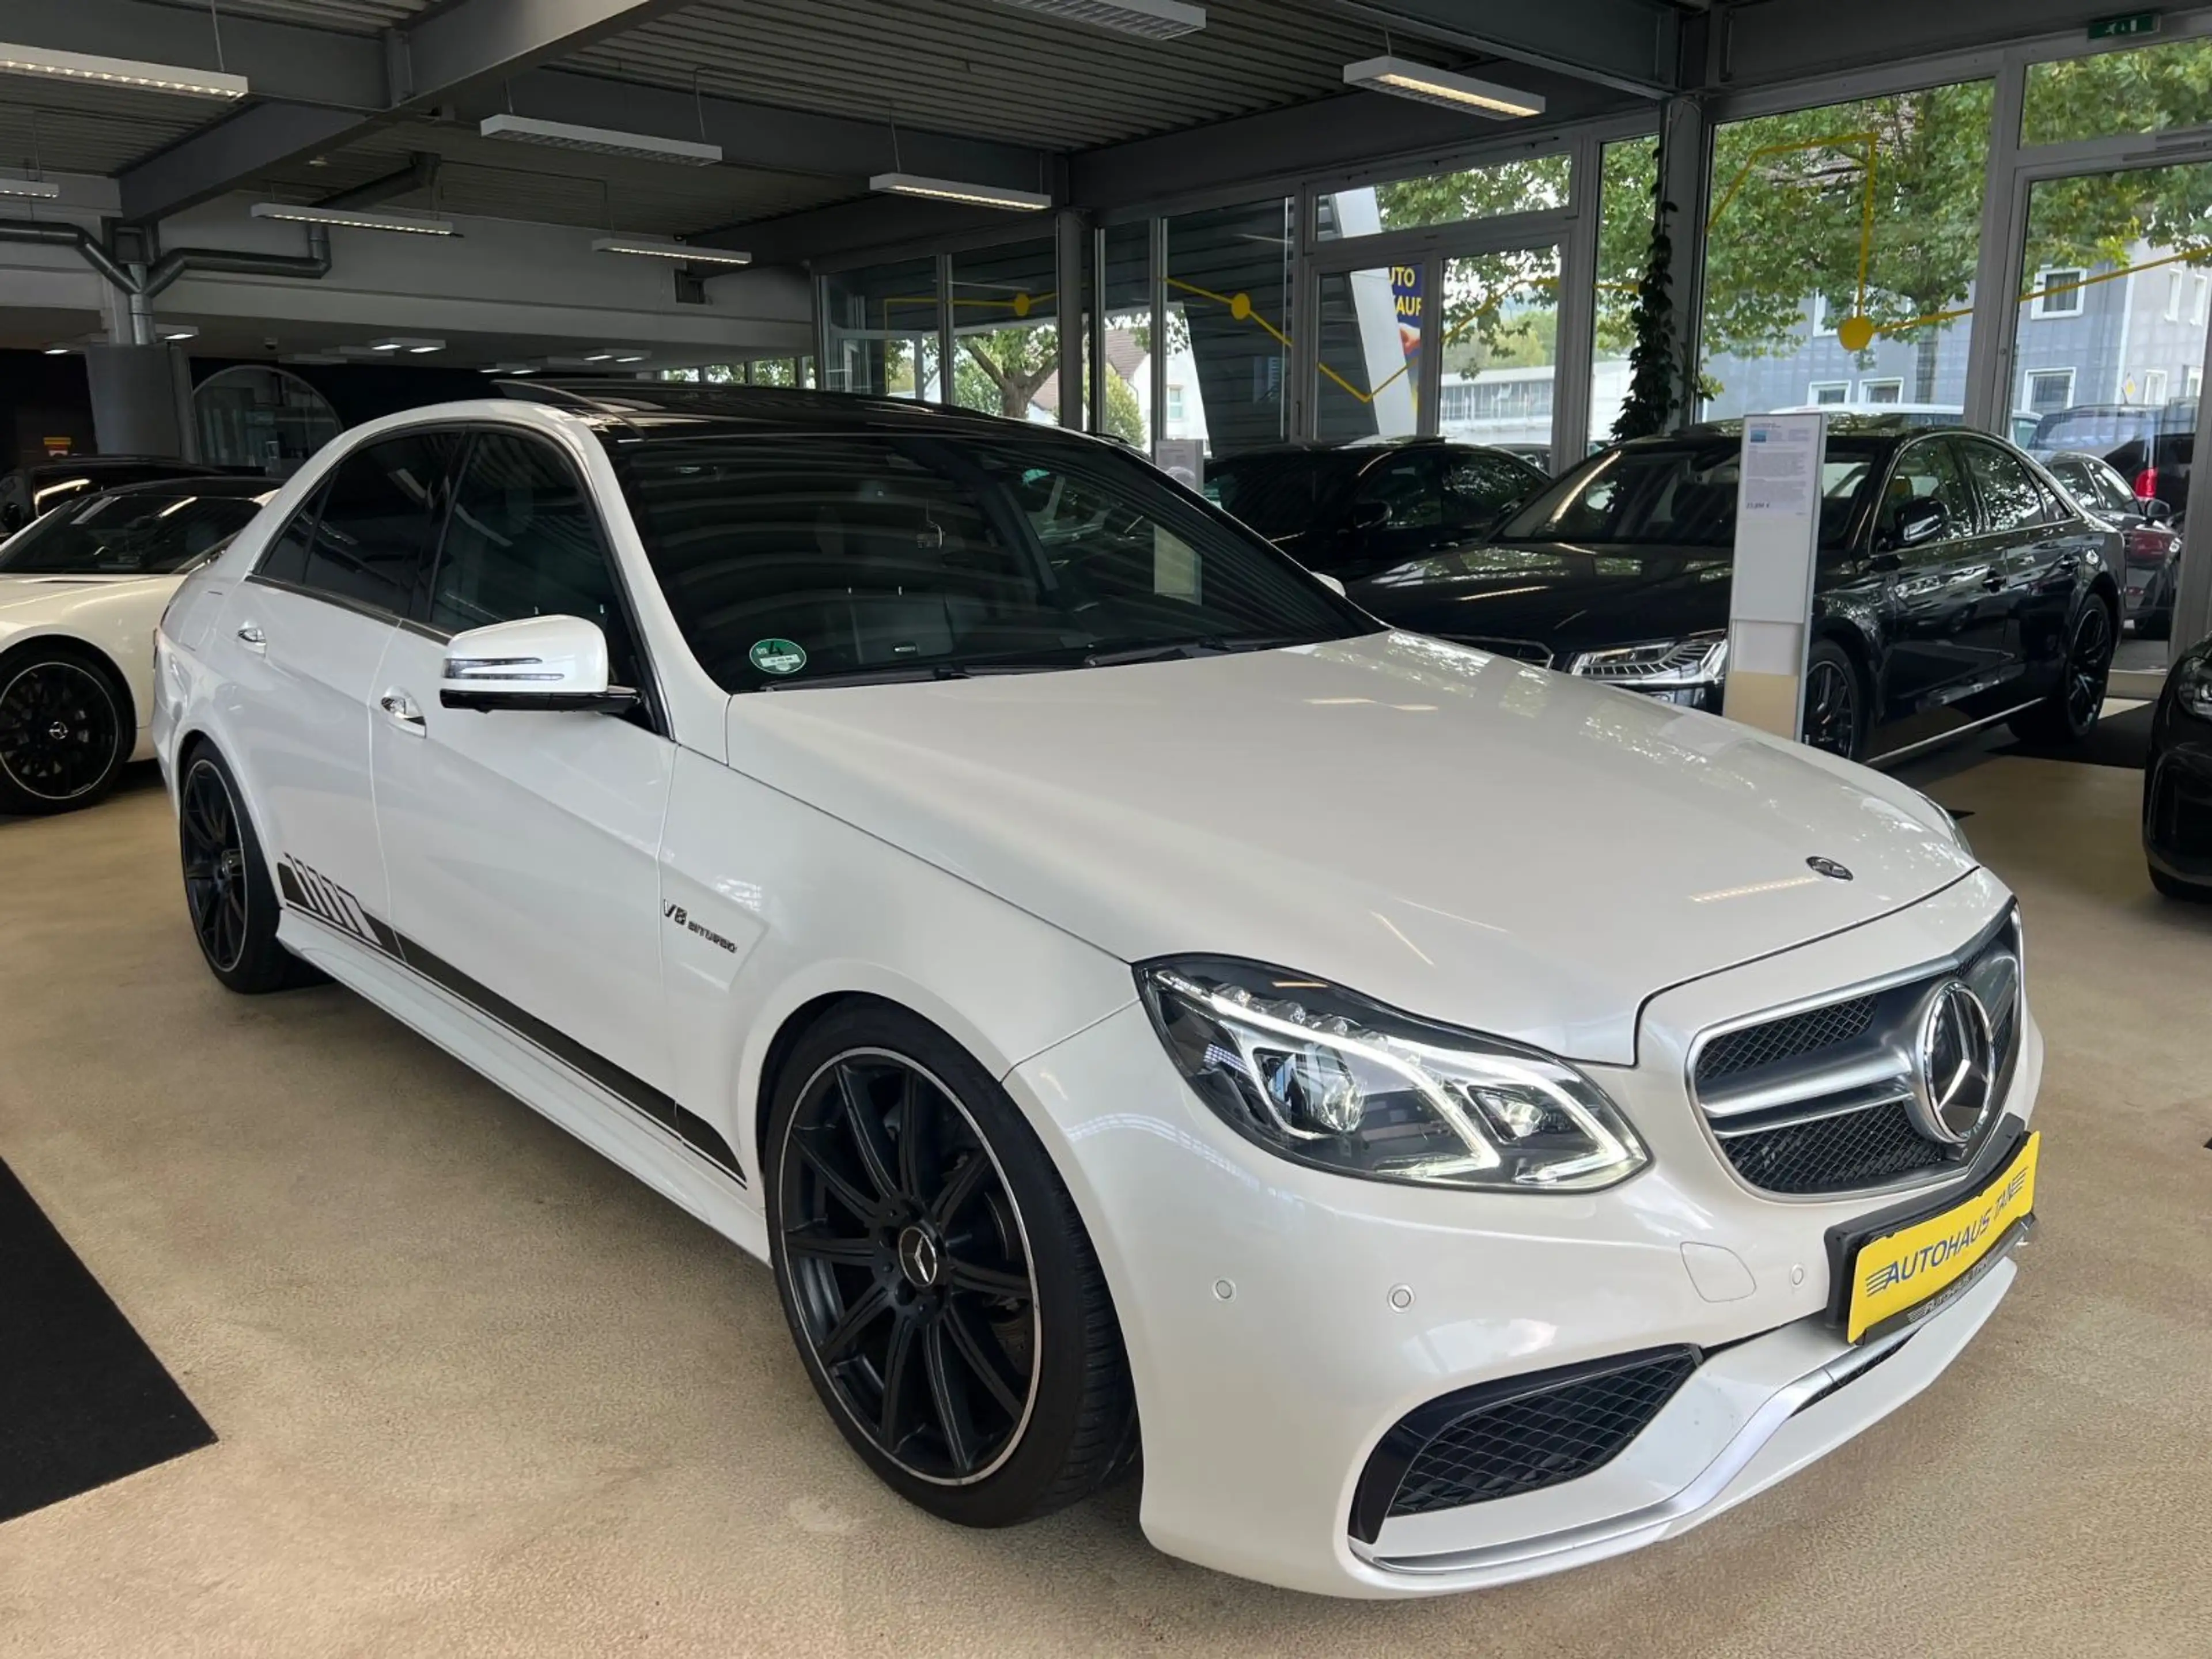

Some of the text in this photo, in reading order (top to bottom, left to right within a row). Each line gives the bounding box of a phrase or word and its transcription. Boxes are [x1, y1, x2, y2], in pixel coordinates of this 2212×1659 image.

[1393, 295, 1422, 316] AUF
[768, 641, 784, 656] 4
[663, 898, 688, 926] V8
[1881, 1207, 1991, 1290] AUTOHAUS
